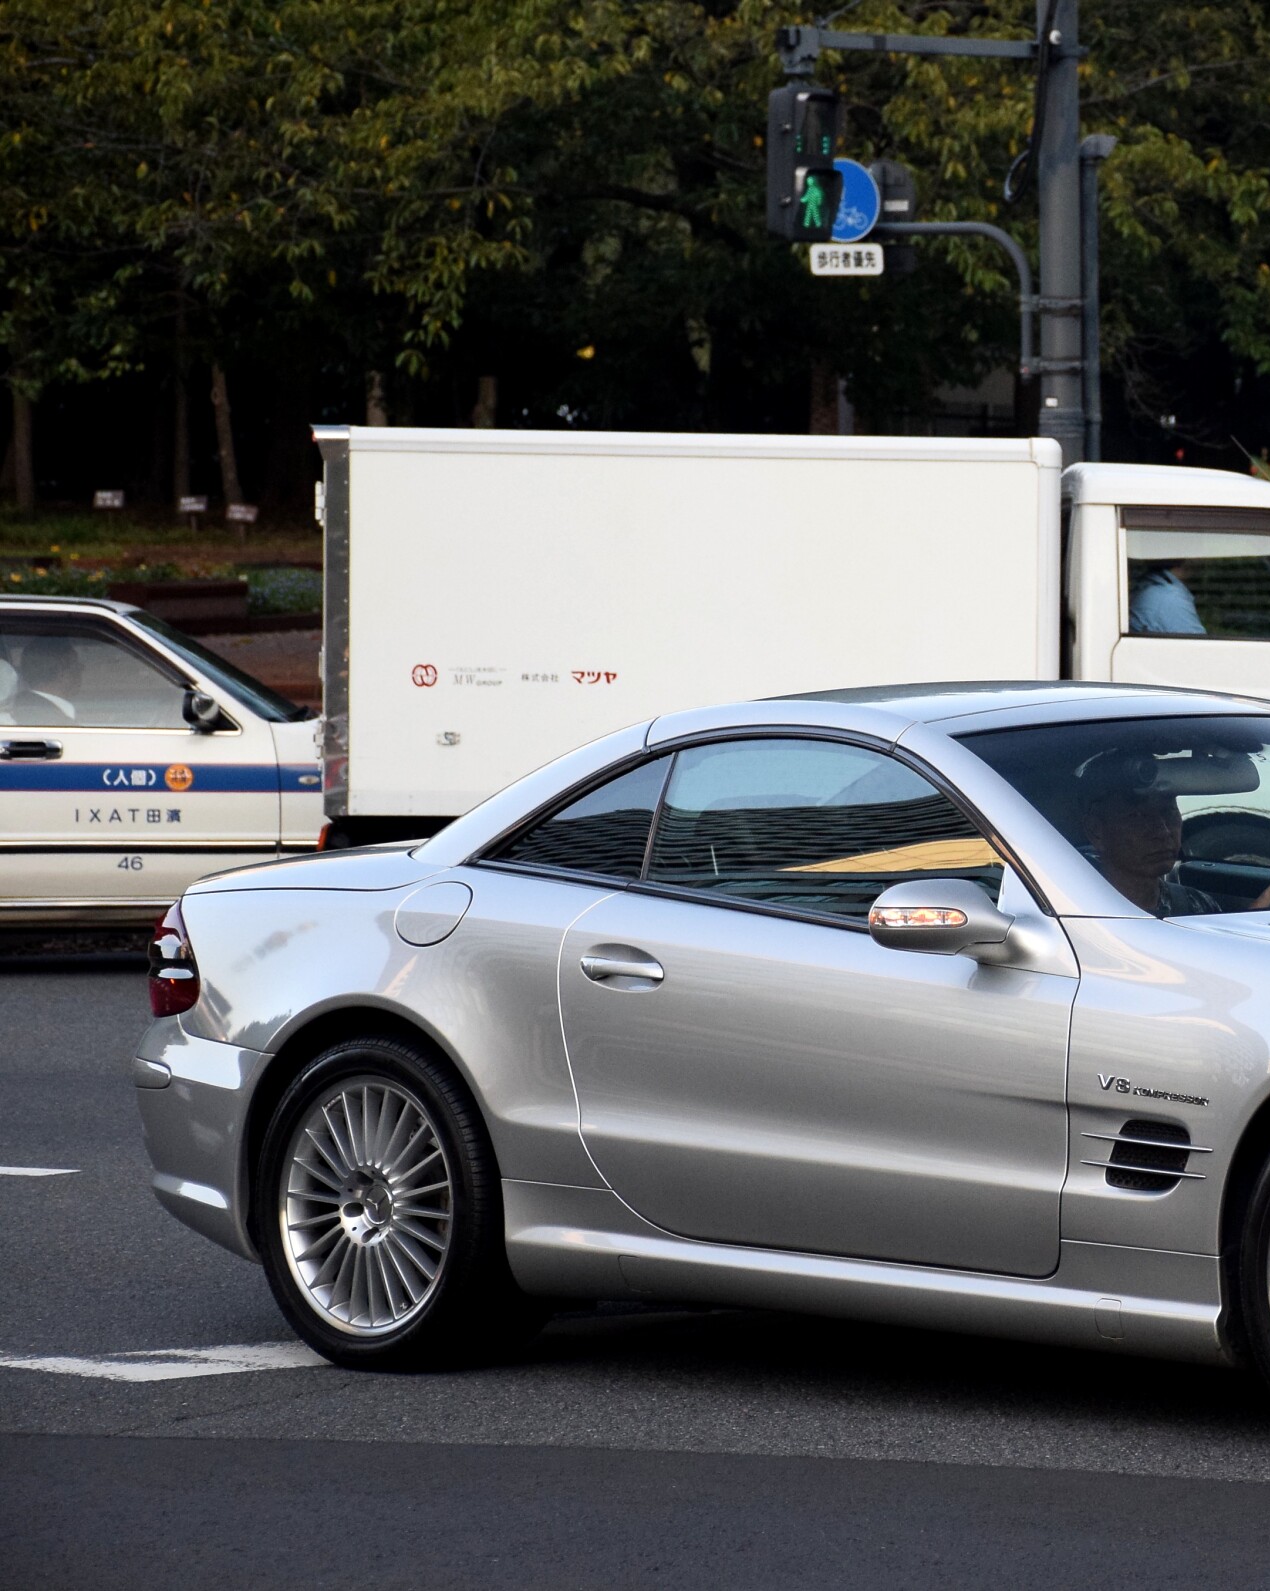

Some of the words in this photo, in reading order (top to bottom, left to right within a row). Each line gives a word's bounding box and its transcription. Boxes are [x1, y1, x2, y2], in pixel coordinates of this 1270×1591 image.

[521, 673, 560, 683] 株式会社
[571, 670, 618, 685] マツヤ
[117, 855, 144, 871] 46
[1097, 1073, 1130, 1094] V8
[1132, 1086, 1209, 1106] KOMPRESSOR
